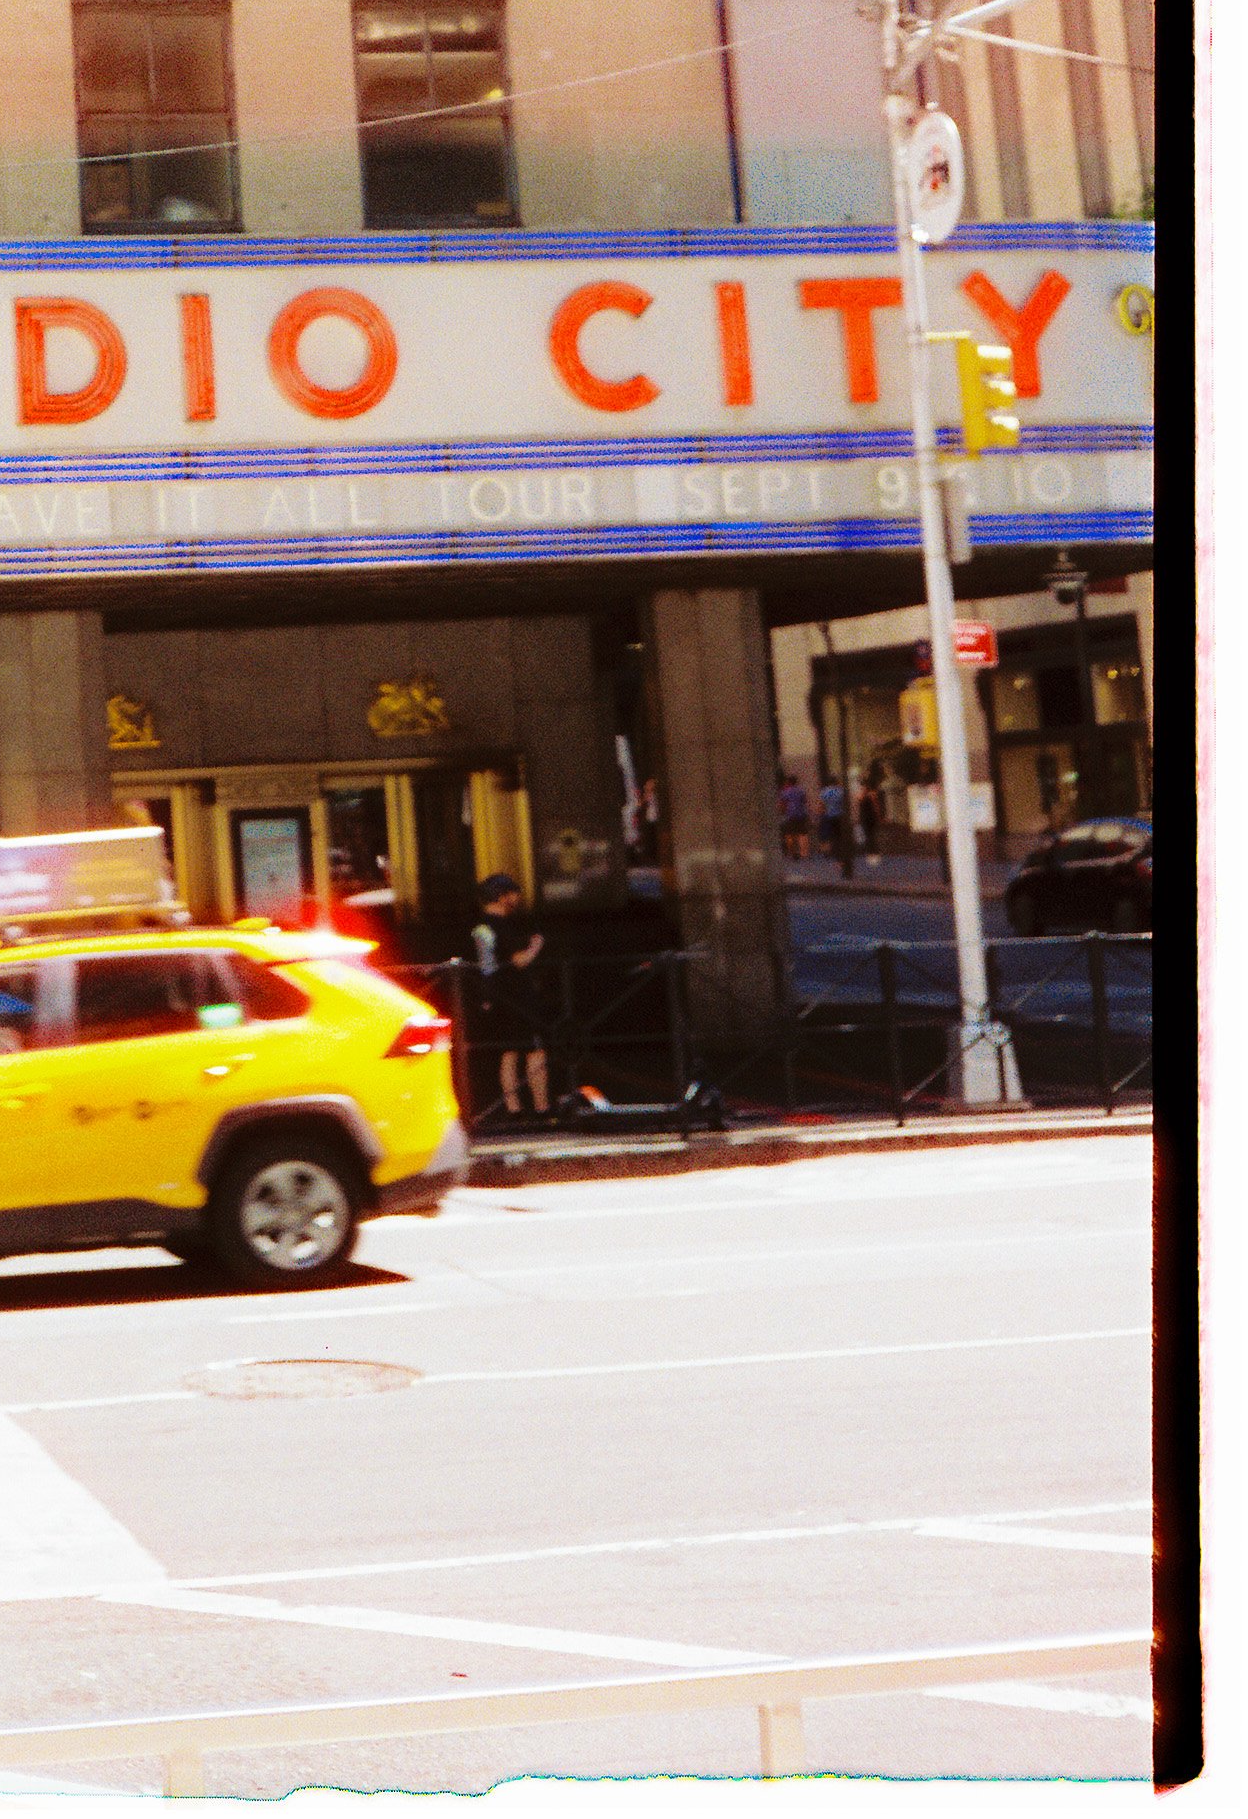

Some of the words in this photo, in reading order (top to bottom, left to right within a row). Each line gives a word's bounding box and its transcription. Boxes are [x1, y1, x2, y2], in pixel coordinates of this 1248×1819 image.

[549, 269, 1072, 413] CITY
[154, 485, 208, 533] IT
[262, 479, 379, 528] ALL
[434, 475, 594, 525] TOUR
[685, 463, 829, 518] SEPT
